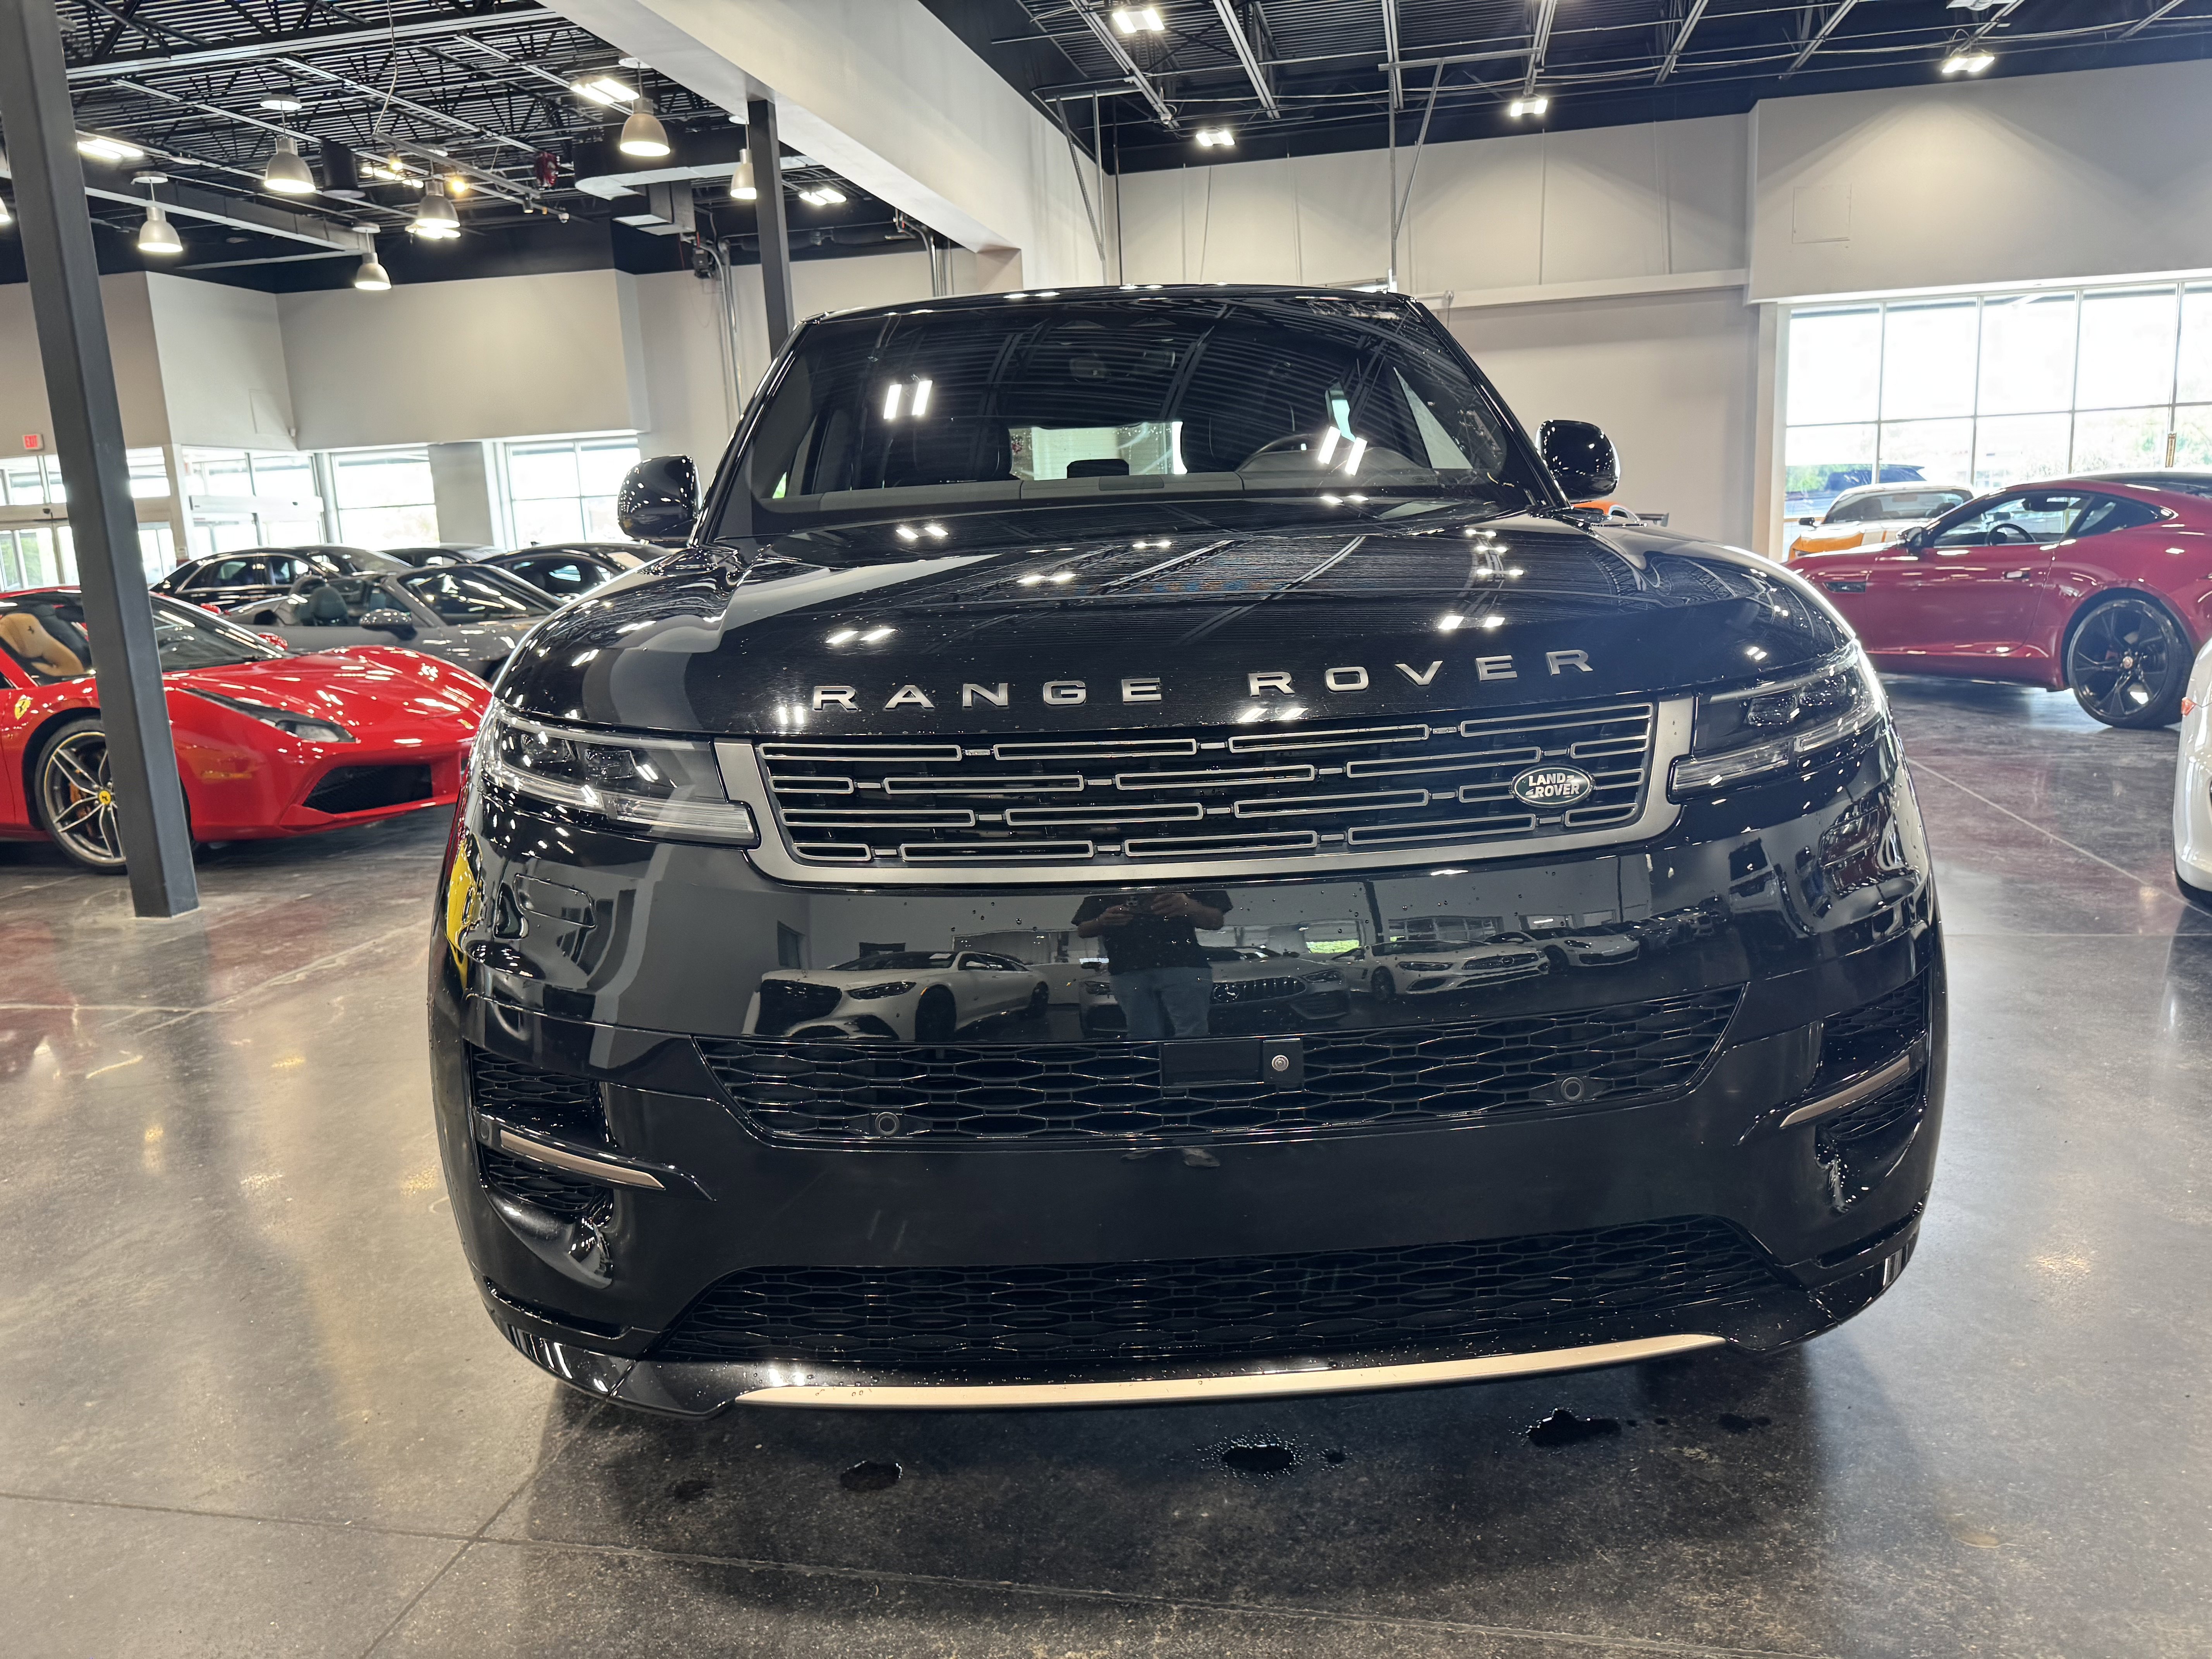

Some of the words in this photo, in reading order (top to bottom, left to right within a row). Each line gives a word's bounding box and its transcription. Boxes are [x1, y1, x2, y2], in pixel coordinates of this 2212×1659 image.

[812, 677, 1163, 711] RANGE
[1248, 649, 1594, 696] ROVER
[1528, 773, 1566, 787] LAND
[1535, 783, 1580, 797] ROVER
